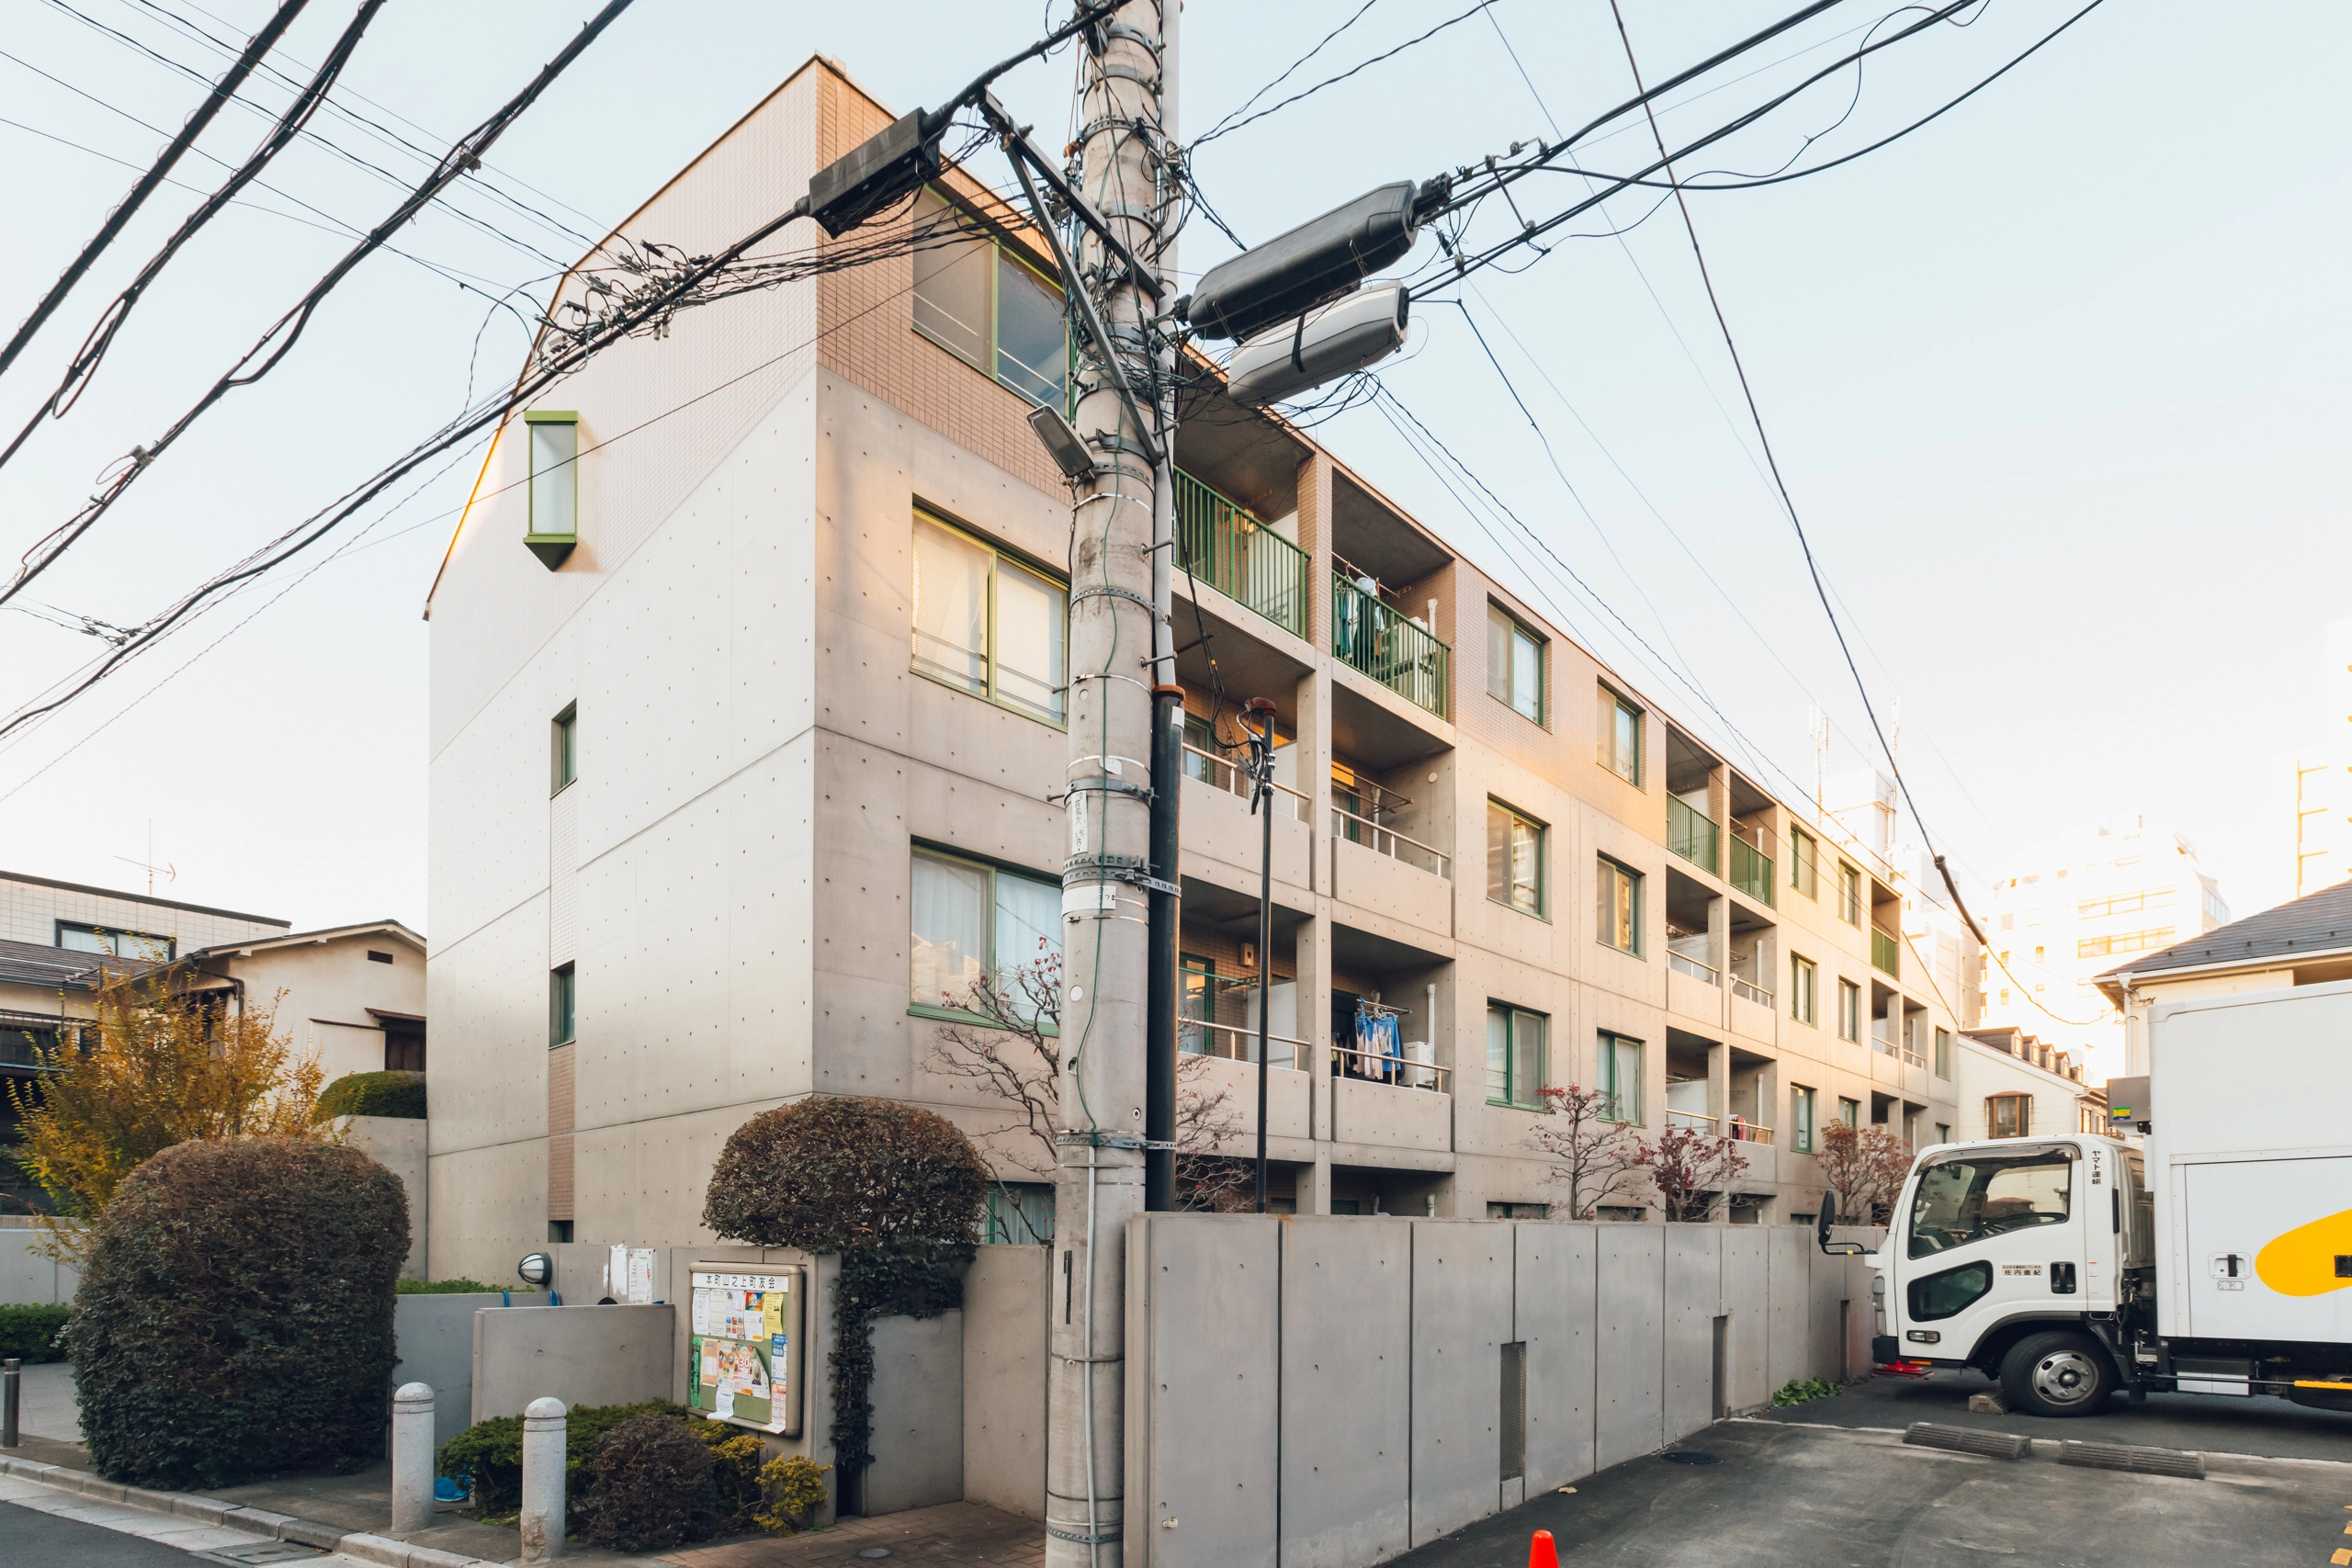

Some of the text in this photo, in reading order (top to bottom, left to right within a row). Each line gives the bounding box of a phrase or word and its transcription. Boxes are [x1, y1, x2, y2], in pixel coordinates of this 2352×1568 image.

[2092, 1150, 2101, 1185] ヤマト運輸
[707, 1274, 775, 1289] 本町山之上町友会
[2219, 1281, 2243, 1290] 冷凍
